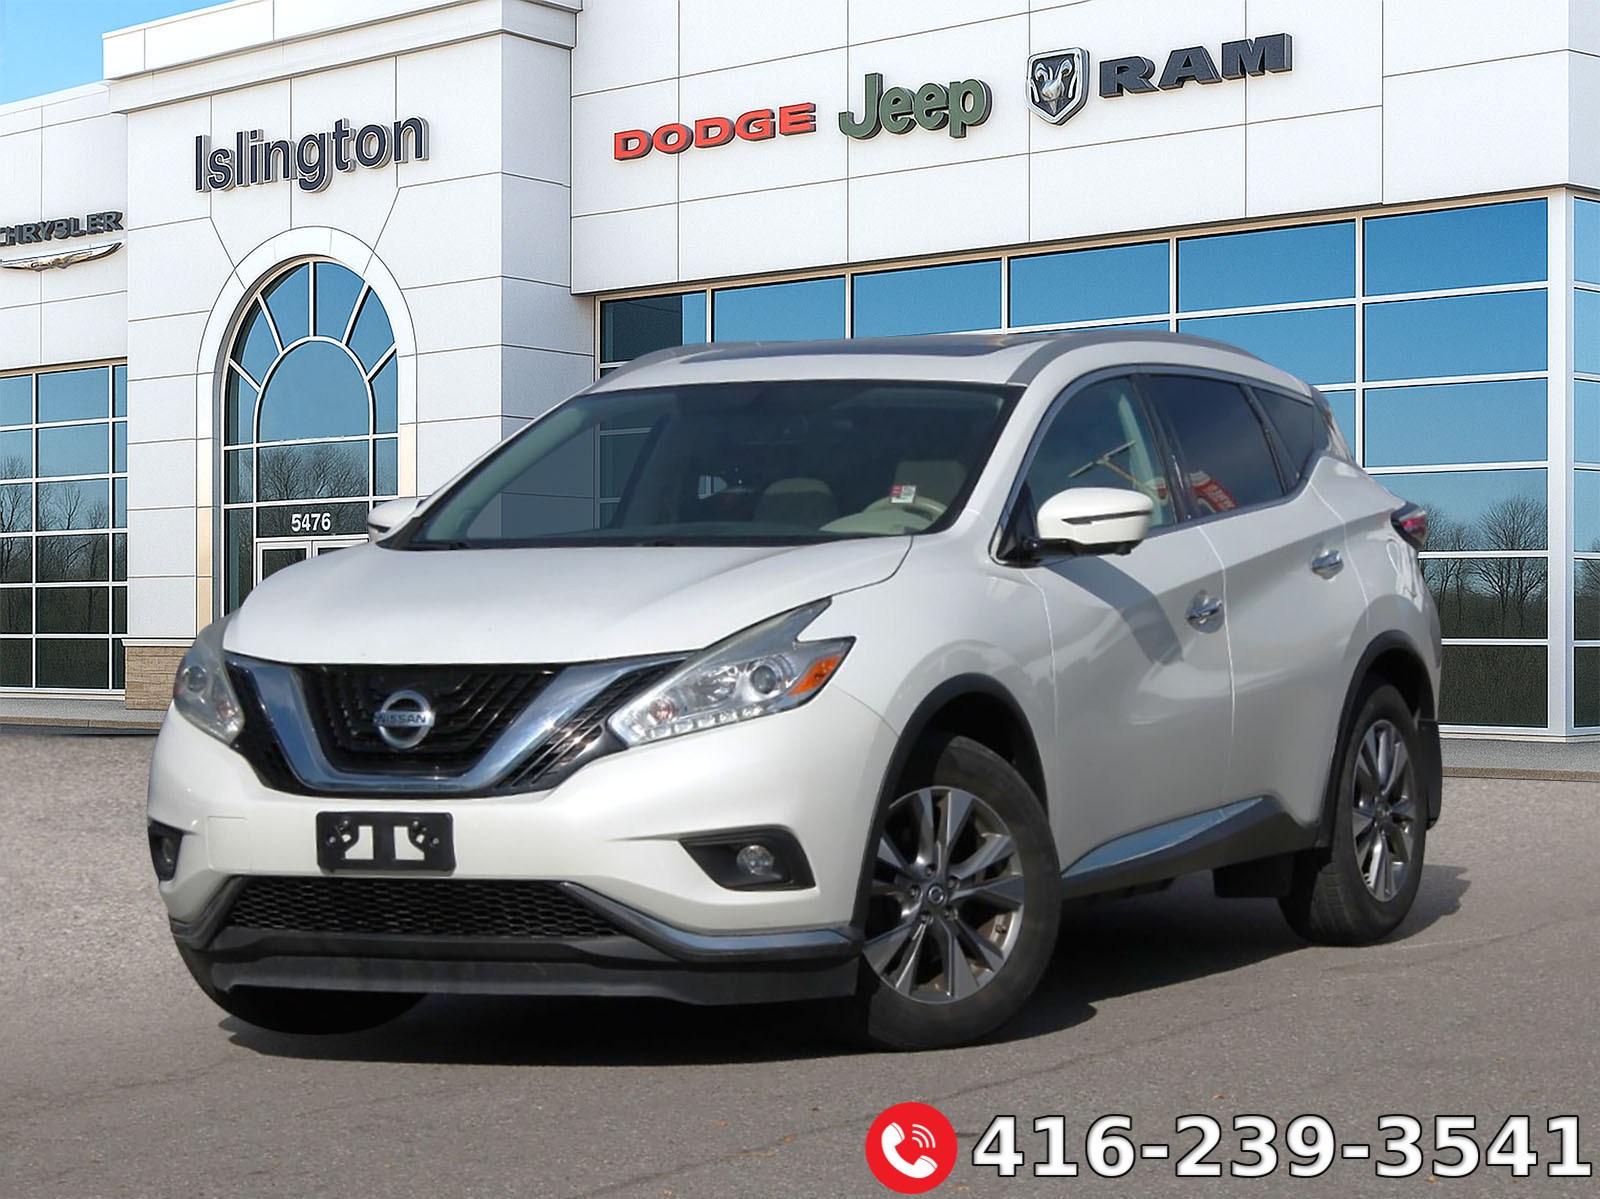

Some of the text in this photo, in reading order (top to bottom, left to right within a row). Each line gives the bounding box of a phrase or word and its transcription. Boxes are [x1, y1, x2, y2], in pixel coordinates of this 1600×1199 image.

[1099, 32, 1294, 98] RAM
[613, 101, 817, 161] DODGE
[837, 72, 993, 140] Jeep
[195, 116, 430, 192] Islington
[290, 511, 332, 533] 5476
[374, 712, 426, 724] NISSAN
